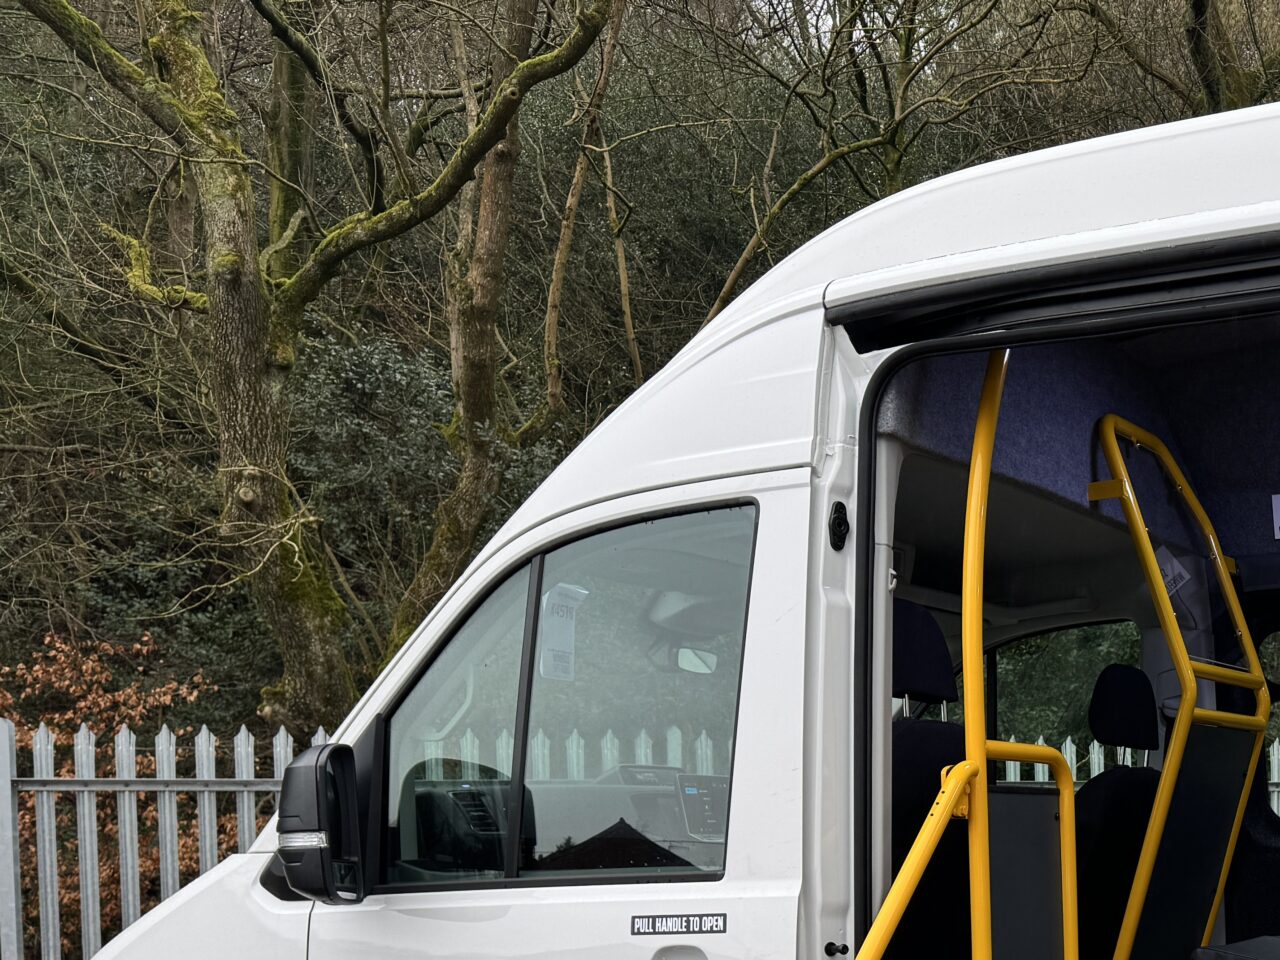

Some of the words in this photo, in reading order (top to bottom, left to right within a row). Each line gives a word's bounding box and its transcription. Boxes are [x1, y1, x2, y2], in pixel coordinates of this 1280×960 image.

[634, 918, 653, 933] PULL
[655, 916, 687, 932] HANDLE
[689, 916, 699, 932] TO
[702, 916, 724, 931] OPEN
